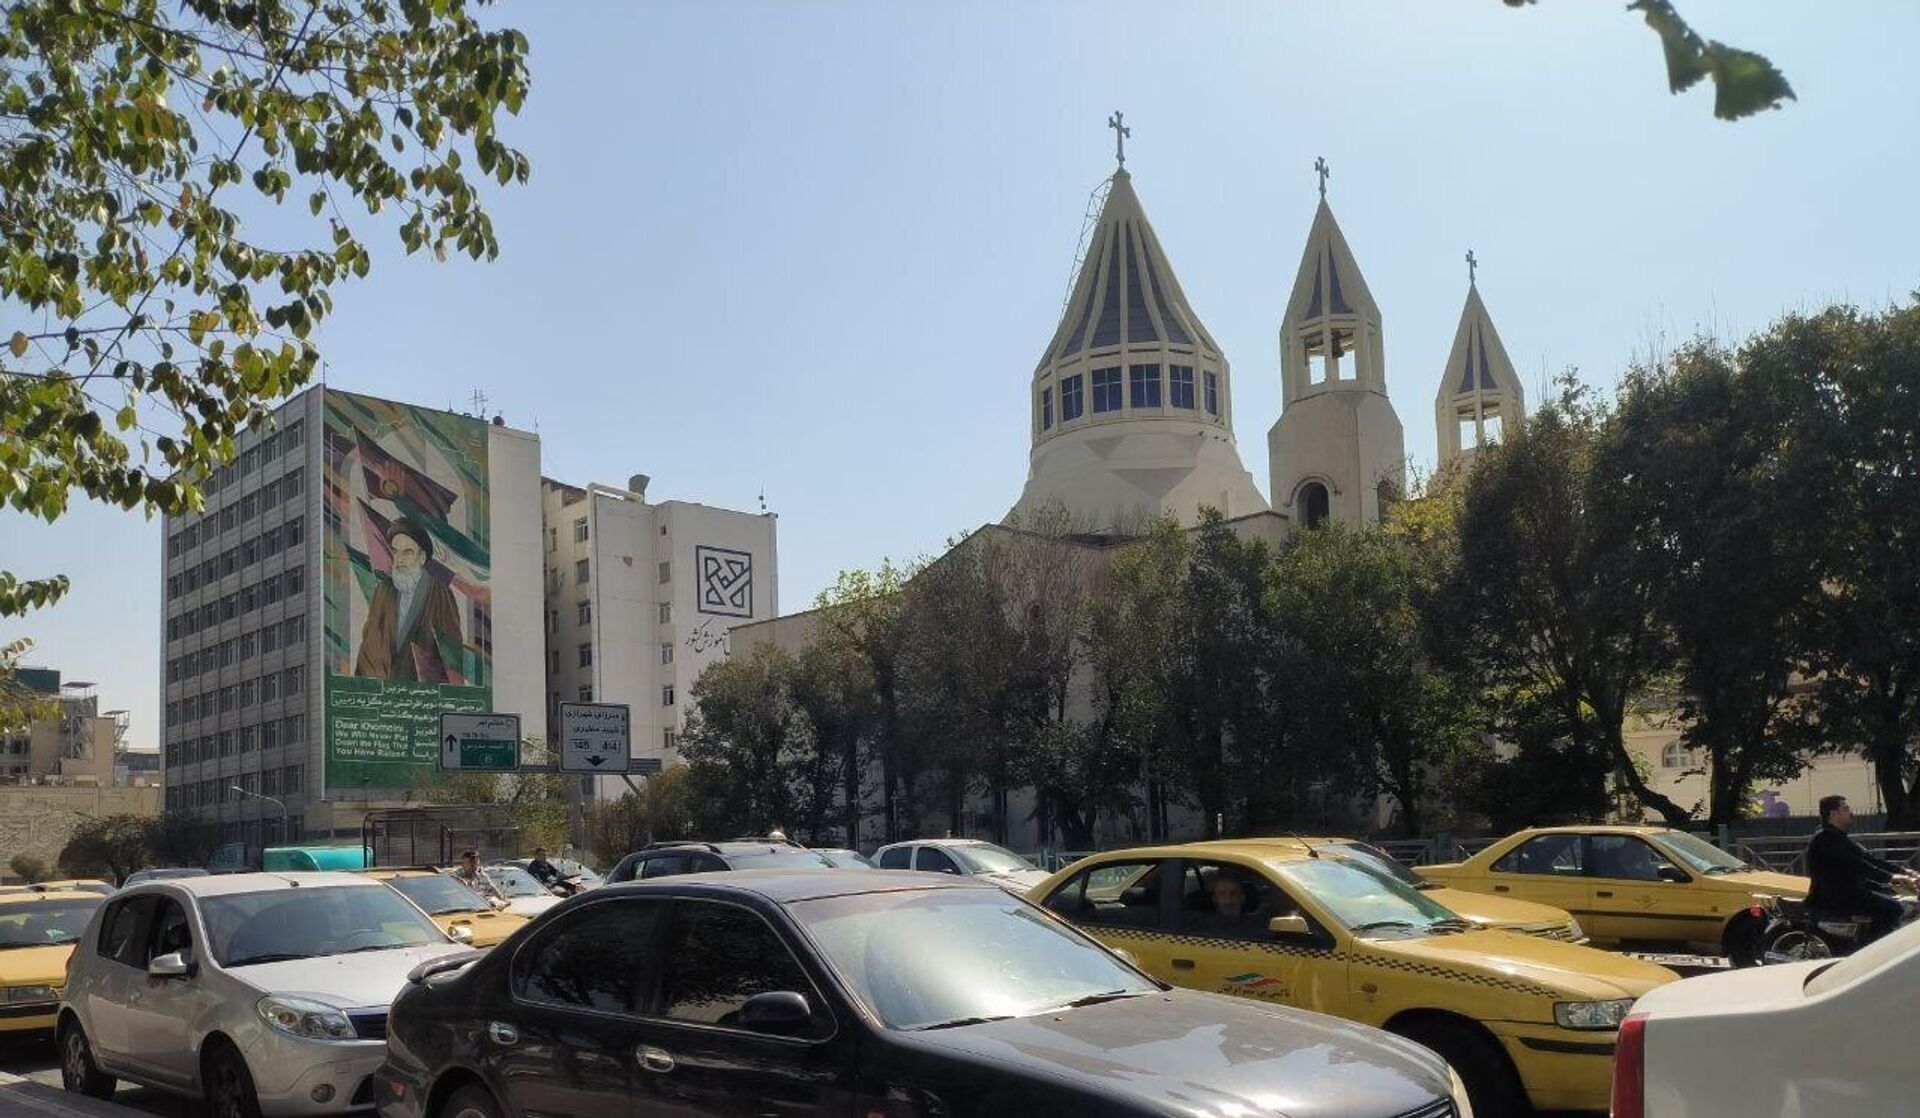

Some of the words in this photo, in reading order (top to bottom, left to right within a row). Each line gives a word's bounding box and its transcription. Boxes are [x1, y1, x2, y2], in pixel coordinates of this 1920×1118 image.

[334, 719, 360, 730] Dear
[334, 729, 349, 738] We
[351, 731, 368, 739] Will
[369, 731, 392, 741] Never
[394, 733, 409, 742] Put
[335, 738, 358, 748] Down
[373, 740, 391, 750] Flag
[392, 741, 409, 750] That
[335, 747, 353, 756] You
[354, 747, 376, 757] Have
